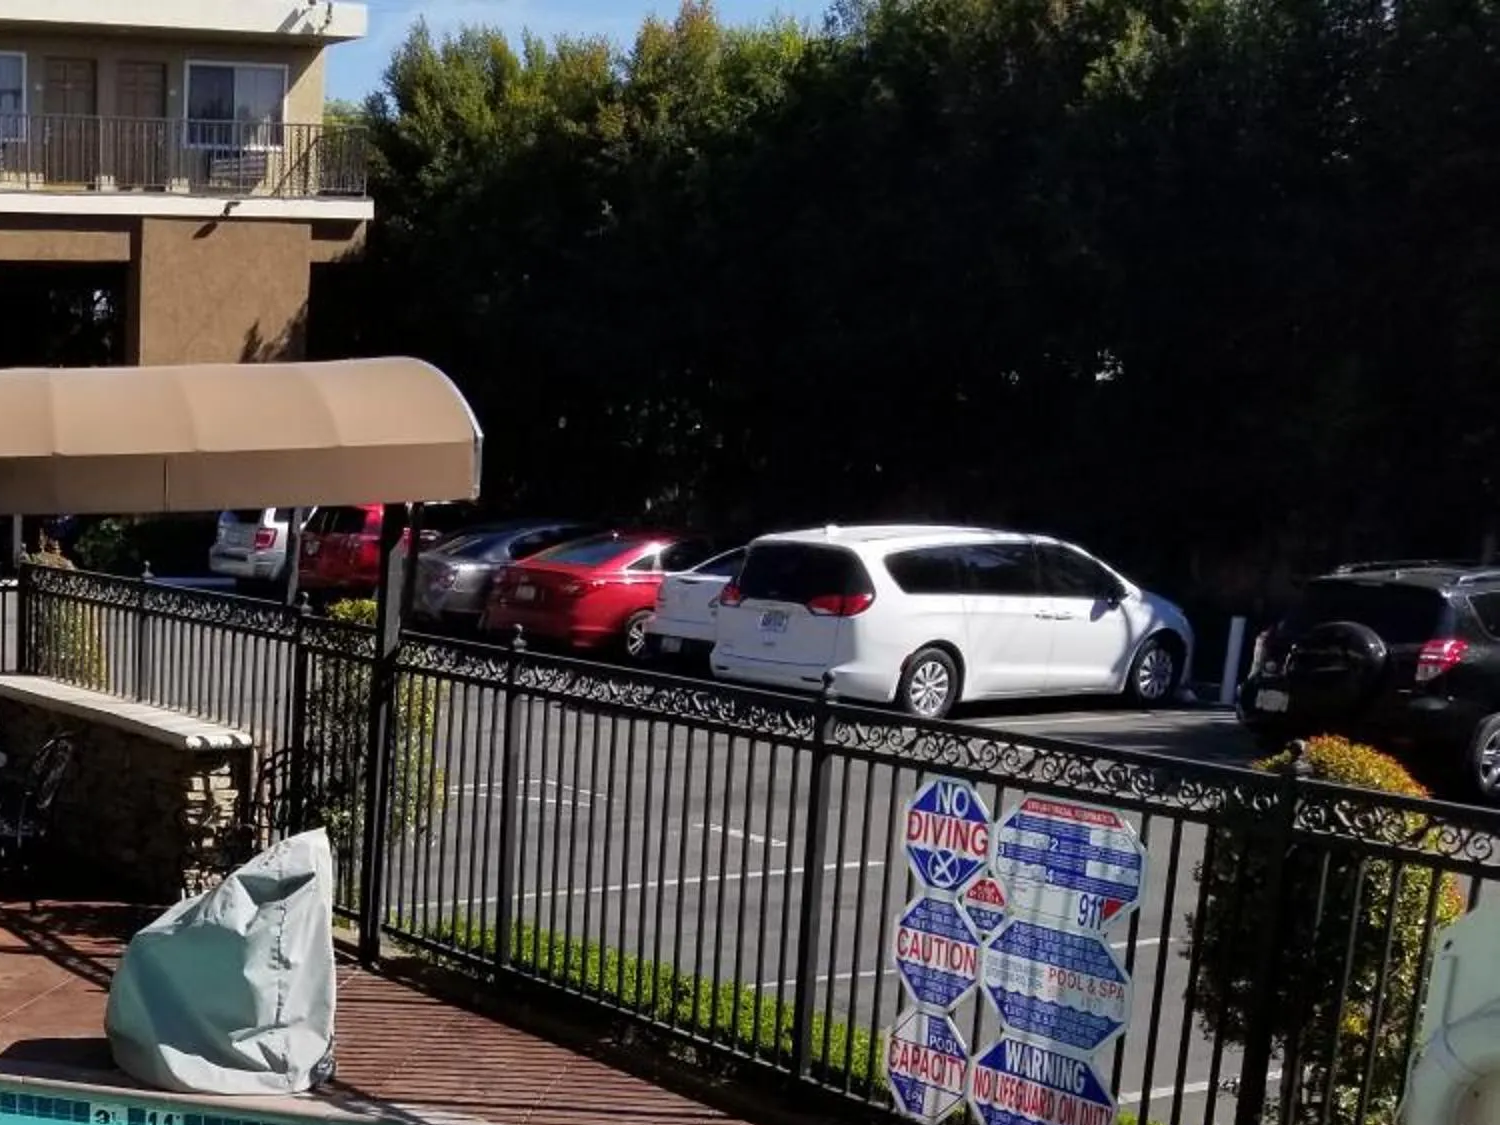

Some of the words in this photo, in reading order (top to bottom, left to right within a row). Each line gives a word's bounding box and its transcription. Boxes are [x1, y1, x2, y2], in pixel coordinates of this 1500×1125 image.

[936, 781, 969, 818] NO
[907, 811, 989, 856] DIVING
[897, 928, 977, 975] CAUTION
[1048, 967, 1084, 991] POOL
[1088, 978, 1096, 995] &
[1099, 980, 1125, 999] SPA
[889, 1038, 968, 1091] CAPACITY
[929, 1035, 958, 1054] POOL
[1005, 1039, 1085, 1094] WARNING
[974, 1066, 991, 1098] NO
[994, 1072, 1055, 1121] LIFEGUARD
